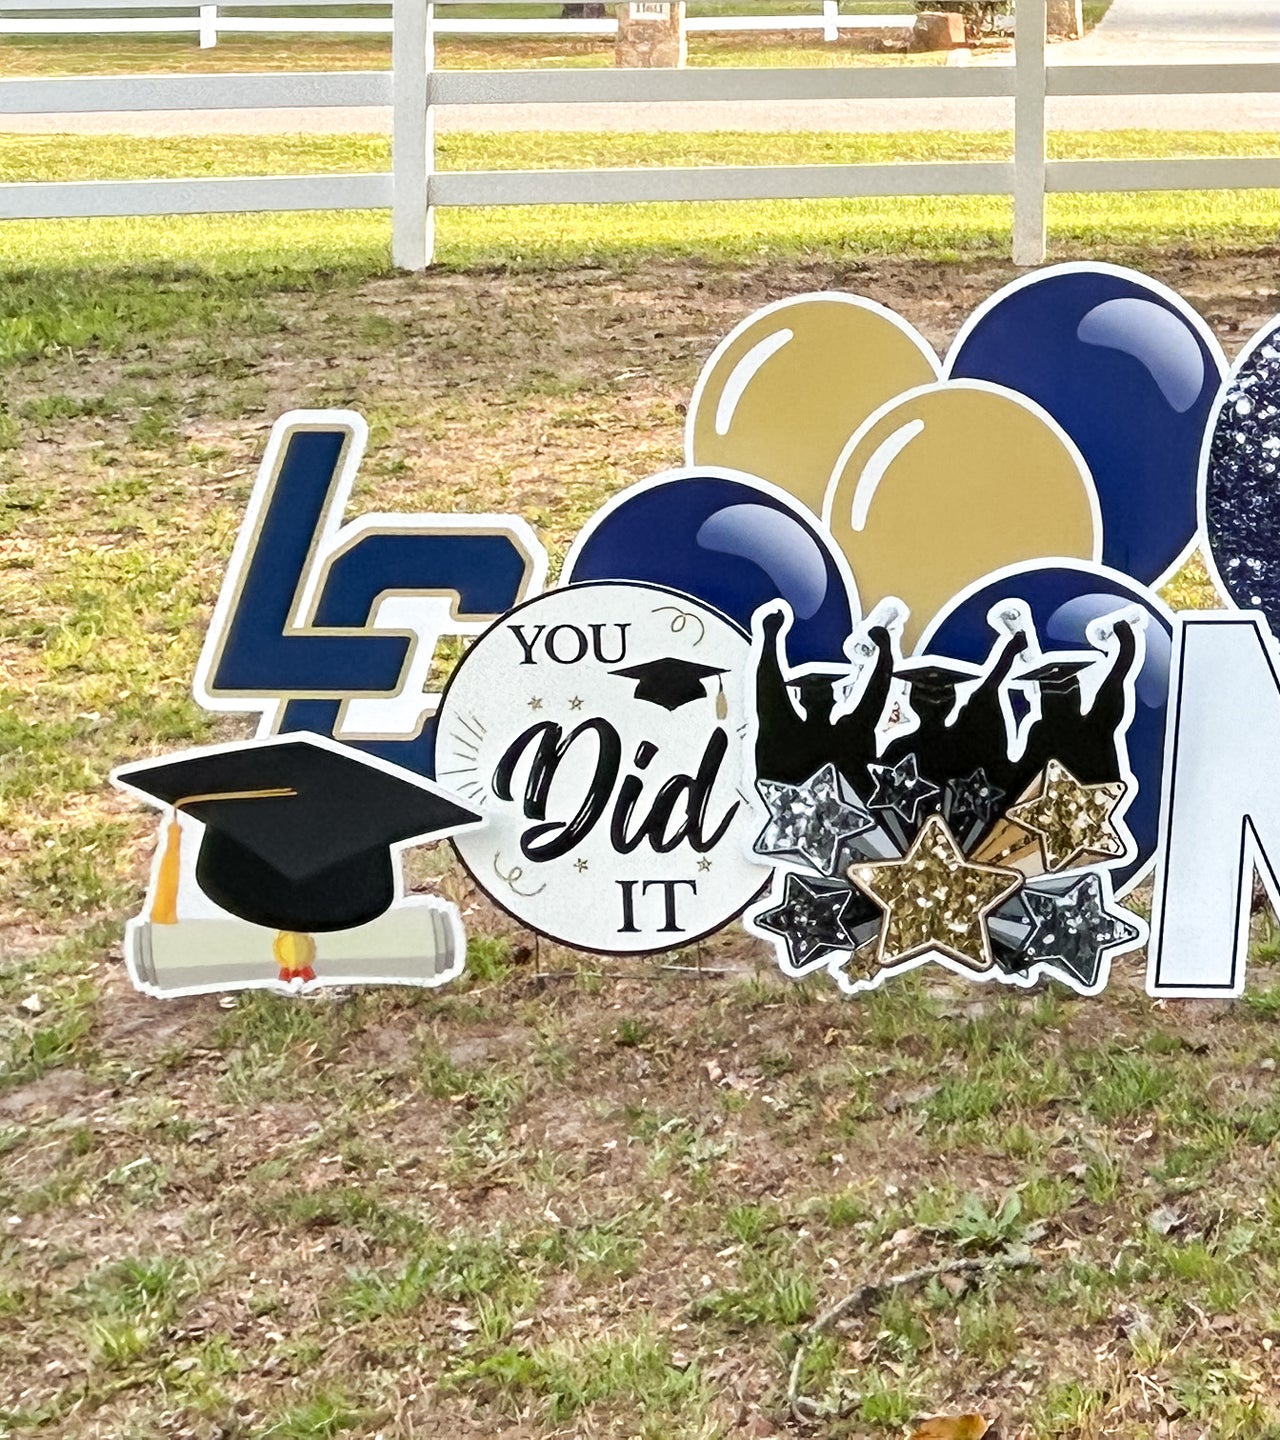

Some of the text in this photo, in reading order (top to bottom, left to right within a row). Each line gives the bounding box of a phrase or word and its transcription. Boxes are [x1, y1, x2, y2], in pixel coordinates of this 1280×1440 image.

[508, 623, 631, 665] YOU
[492, 717, 741, 863] Did
[616, 878, 698, 934] IT
